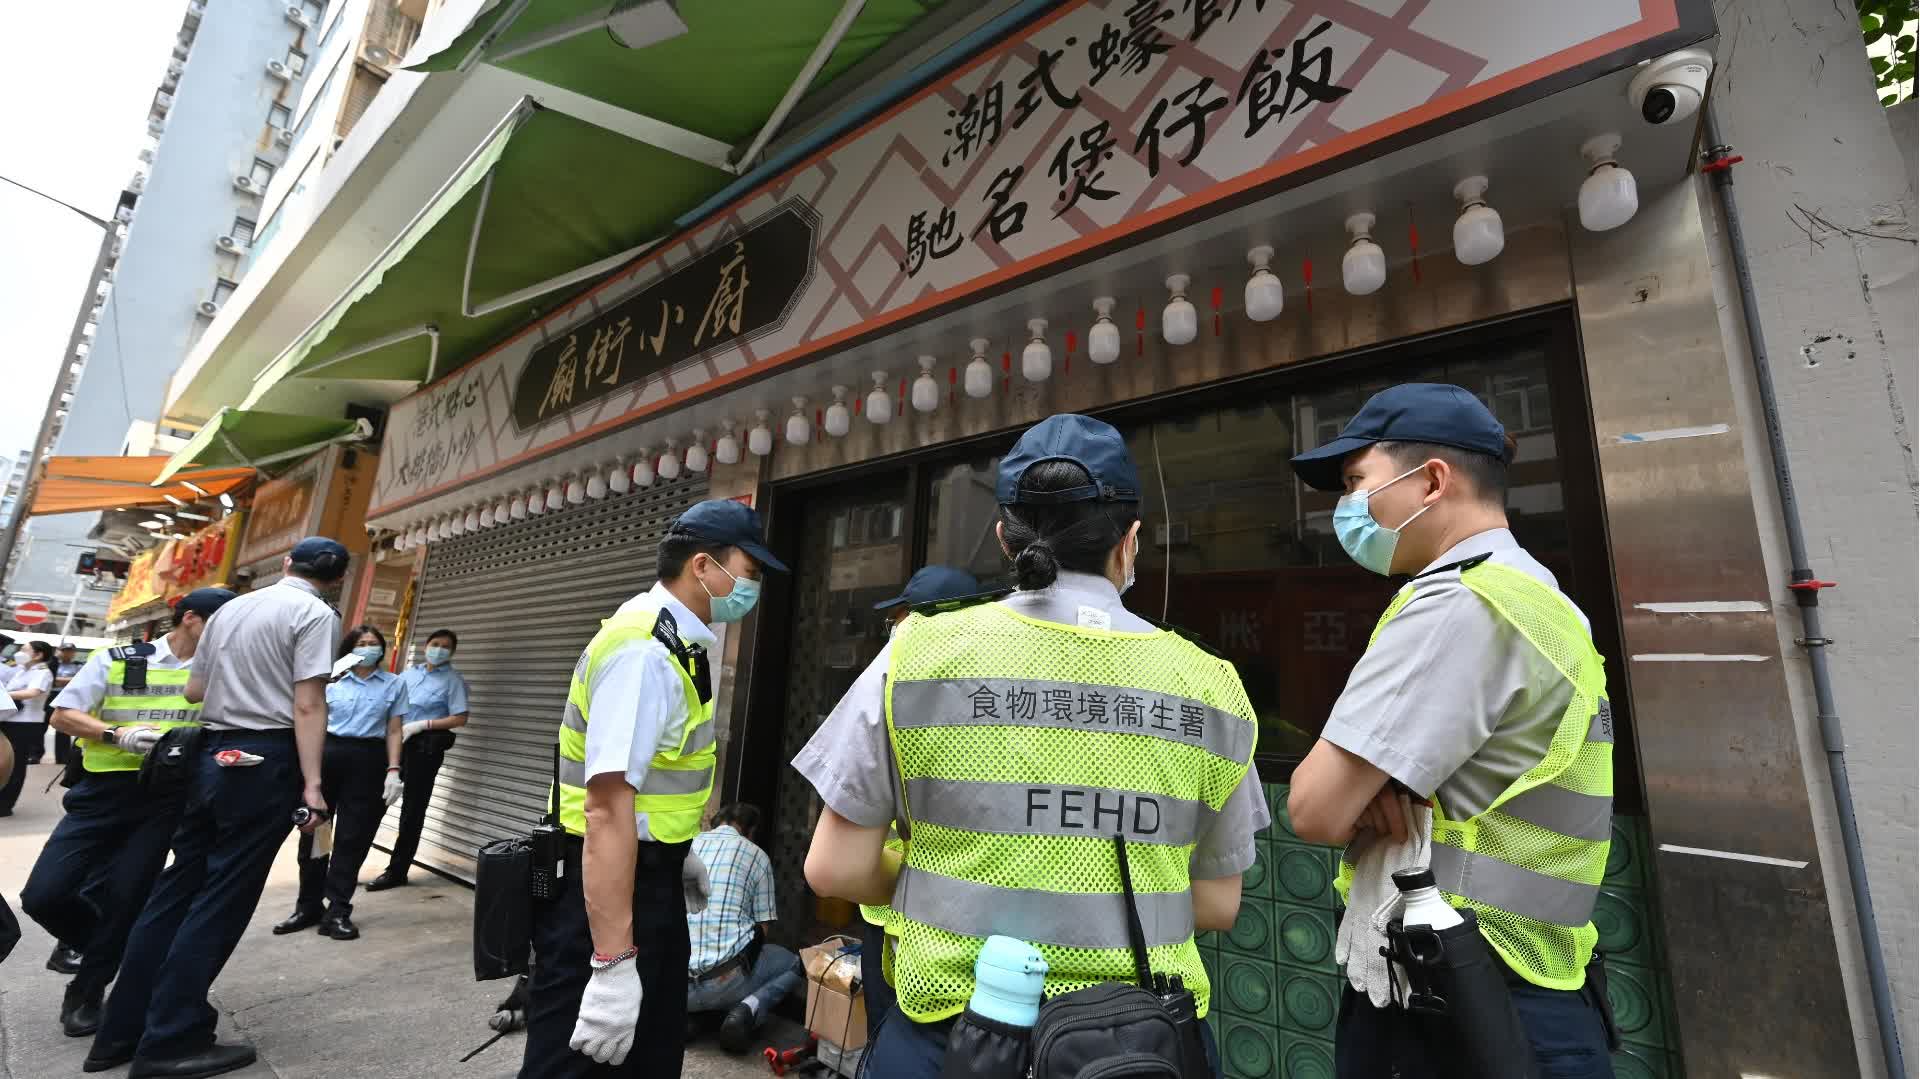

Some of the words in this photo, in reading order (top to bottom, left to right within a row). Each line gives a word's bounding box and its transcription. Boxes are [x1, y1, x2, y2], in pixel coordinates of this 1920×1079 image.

[900, 20, 1352, 278] 馳名煲仔飯
[538, 241, 750, 418] 廟街小廚
[1026, 788, 1161, 835] FEHD
